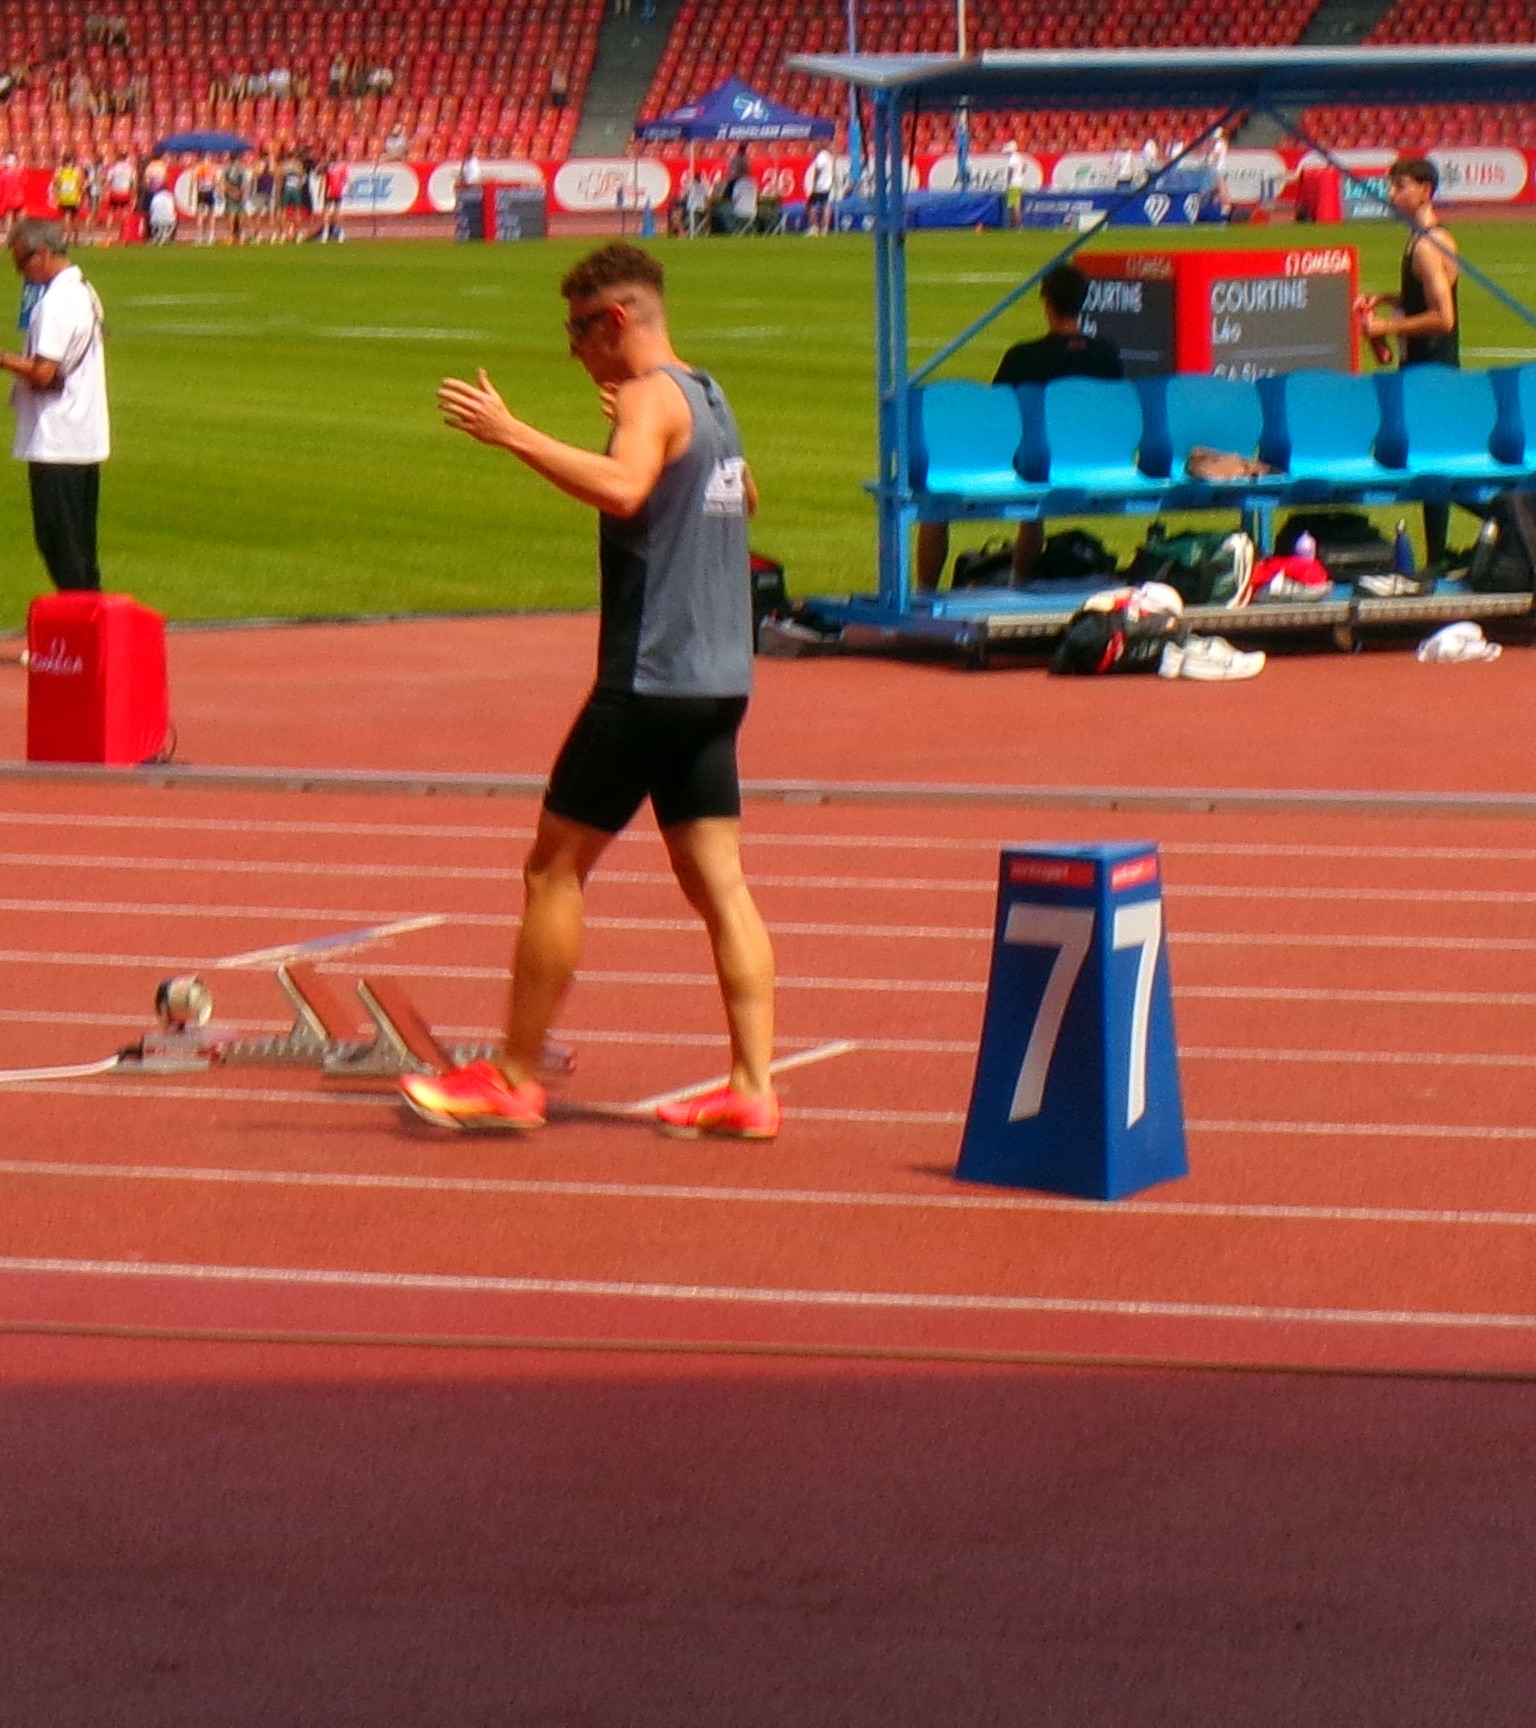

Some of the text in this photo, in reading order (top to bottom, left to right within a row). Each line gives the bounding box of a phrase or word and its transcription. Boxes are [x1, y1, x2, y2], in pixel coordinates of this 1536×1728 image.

[1211, 278, 1308, 313] COURTINE
[1004, 902, 1096, 1123] 7
[1113, 898, 1161, 1129] 7
